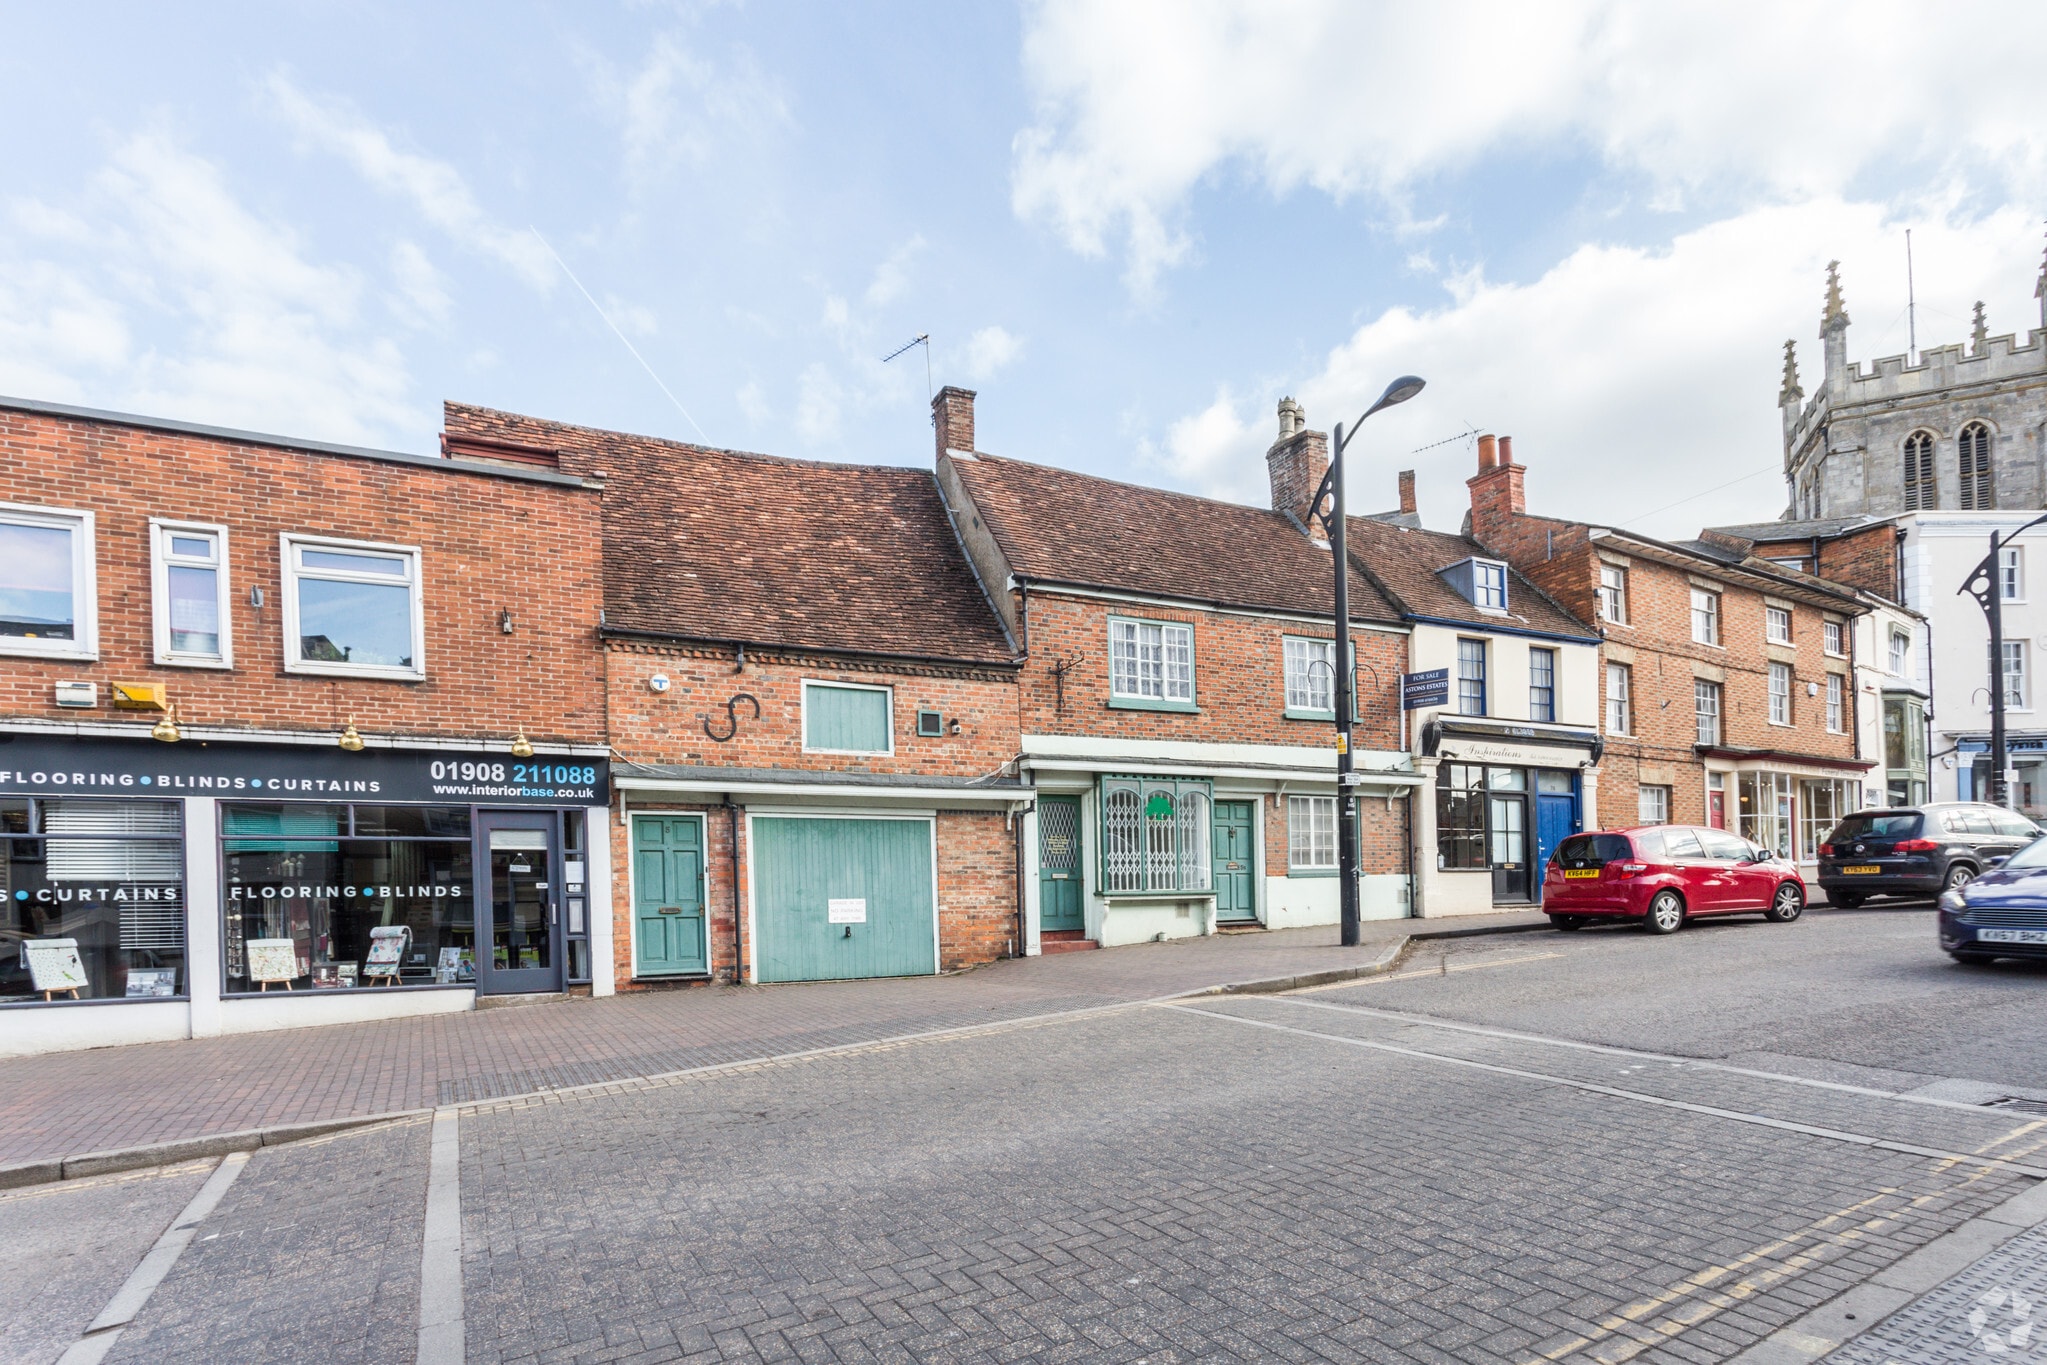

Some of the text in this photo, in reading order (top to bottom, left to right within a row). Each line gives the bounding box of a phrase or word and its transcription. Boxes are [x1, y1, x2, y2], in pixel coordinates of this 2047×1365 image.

[1413, 671, 1440, 682] FOR SALE
[1405, 681, 1448, 693] ASTONS ESTATES
[1464, 744, 1522, 758] Inspirations
[430, 760, 596, 785] 01908 211088
[0, 771, 381, 792] FLOORING BLINDS CURTAINS
[433, 784, 594, 799] www.interiorbase.co.uk
[36, 888, 177, 901] CURTAINS
[231, 885, 462, 900] FLOORING BLINDS
